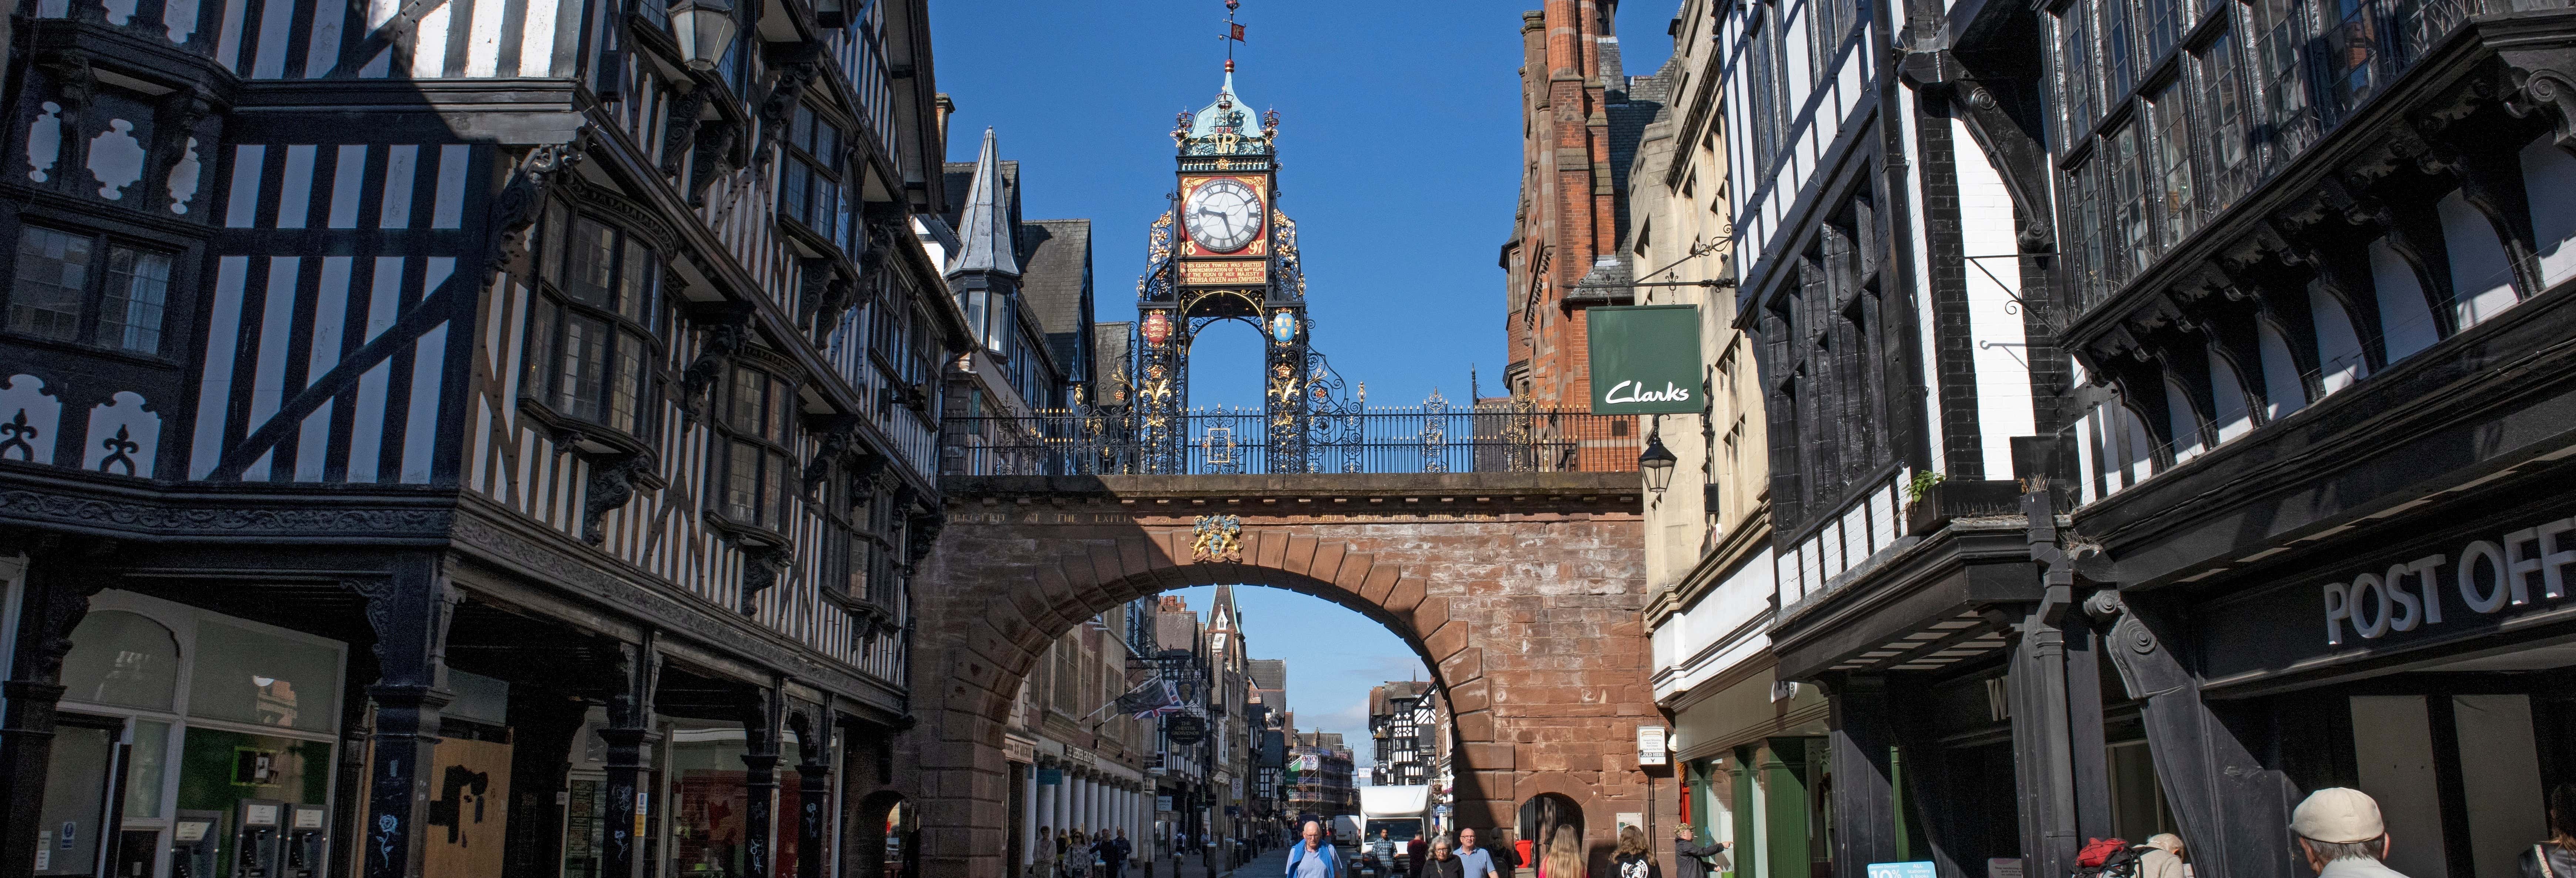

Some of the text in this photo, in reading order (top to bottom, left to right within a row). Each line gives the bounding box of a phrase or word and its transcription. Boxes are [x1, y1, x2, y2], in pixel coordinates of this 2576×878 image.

[1181, 240, 1196, 255] 18
[1248, 239, 1265, 255] 97
[1605, 380, 1689, 404] Clarks
[1054, 514, 1077, 523] THE
[1309, 512, 1337, 522] LORD
[1344, 512, 1411, 521] GROSVENOR
[2324, 515, 2576, 645] POST OFF
[1870, 869, 1902, 878] 10%
